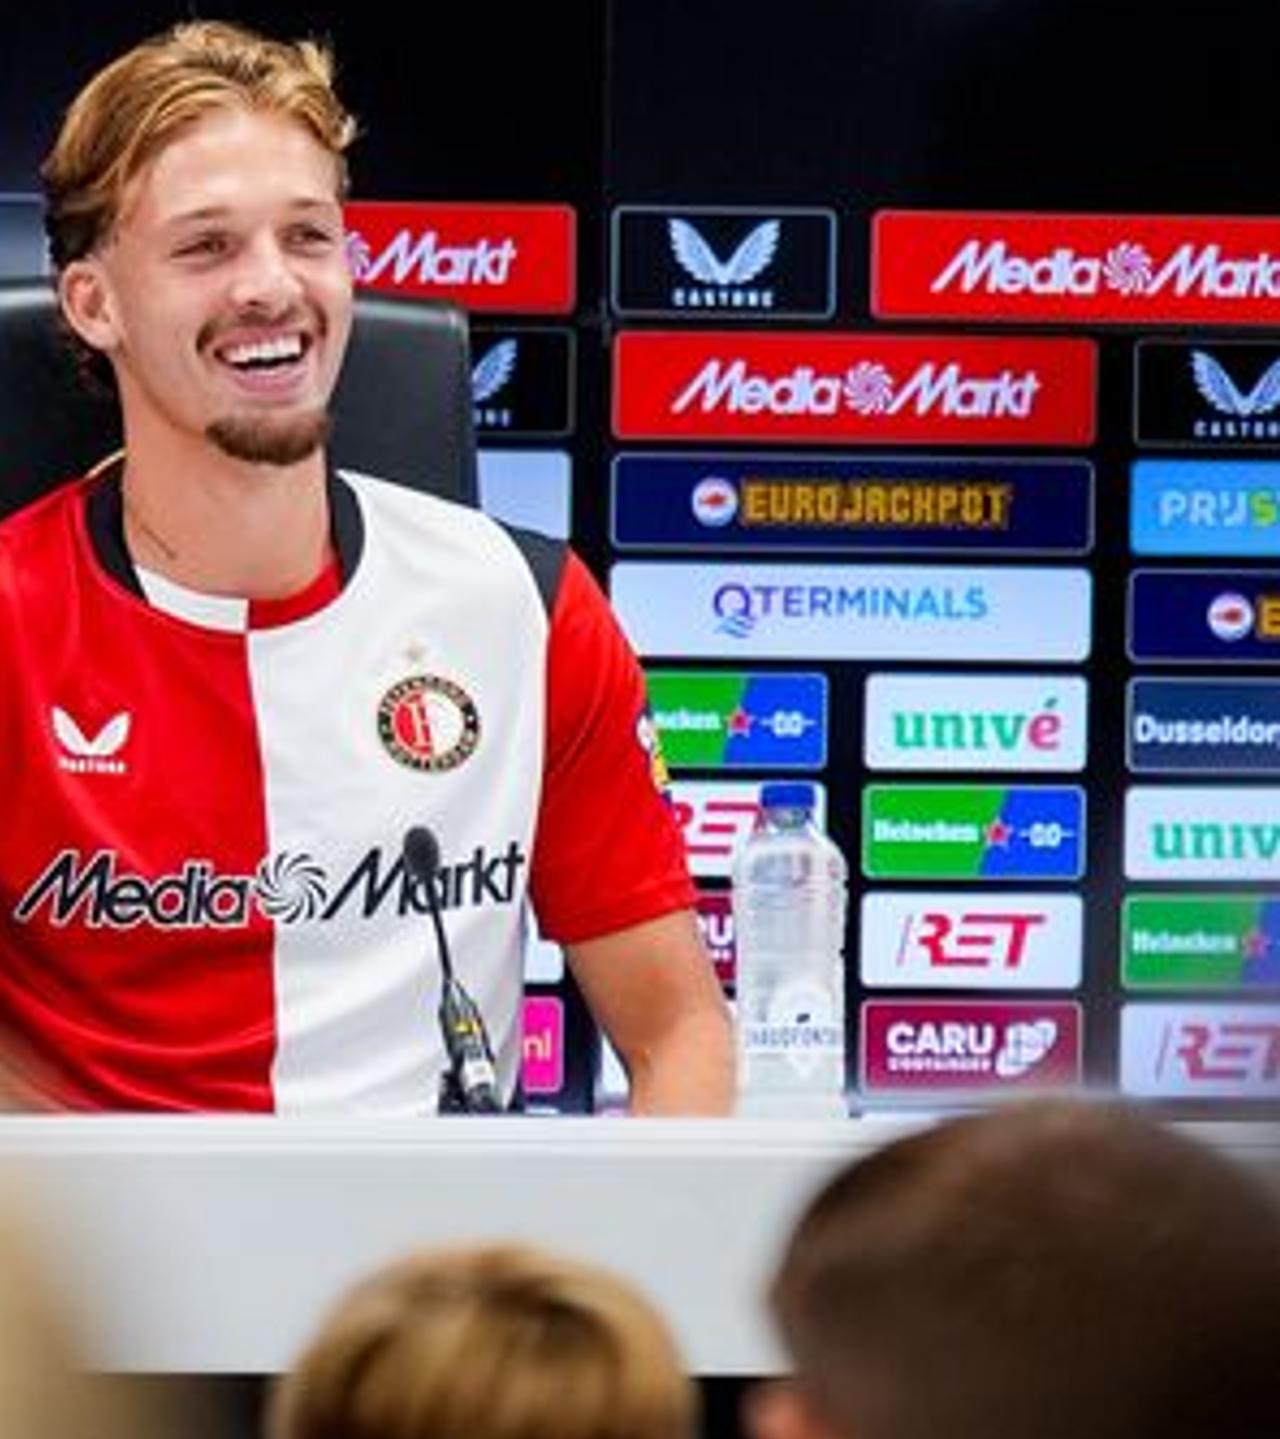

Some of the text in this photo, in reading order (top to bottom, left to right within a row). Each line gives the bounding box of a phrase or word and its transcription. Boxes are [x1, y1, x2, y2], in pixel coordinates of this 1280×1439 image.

[365, 230, 516, 286] Markt
[932, 240, 1280, 297] Media Mark
[671, 359, 1040, 417] Media Markt
[744, 484, 1011, 527] EUROJACKPOT
[1159, 491, 1280, 527] PRIJS
[893, 698, 1061, 749] univé
[1134, 715, 1280, 744] Dusseldor
[1152, 824, 1280, 859] univ
[15, 850, 254, 929] Media
[886, 1024, 992, 1054] CARU
